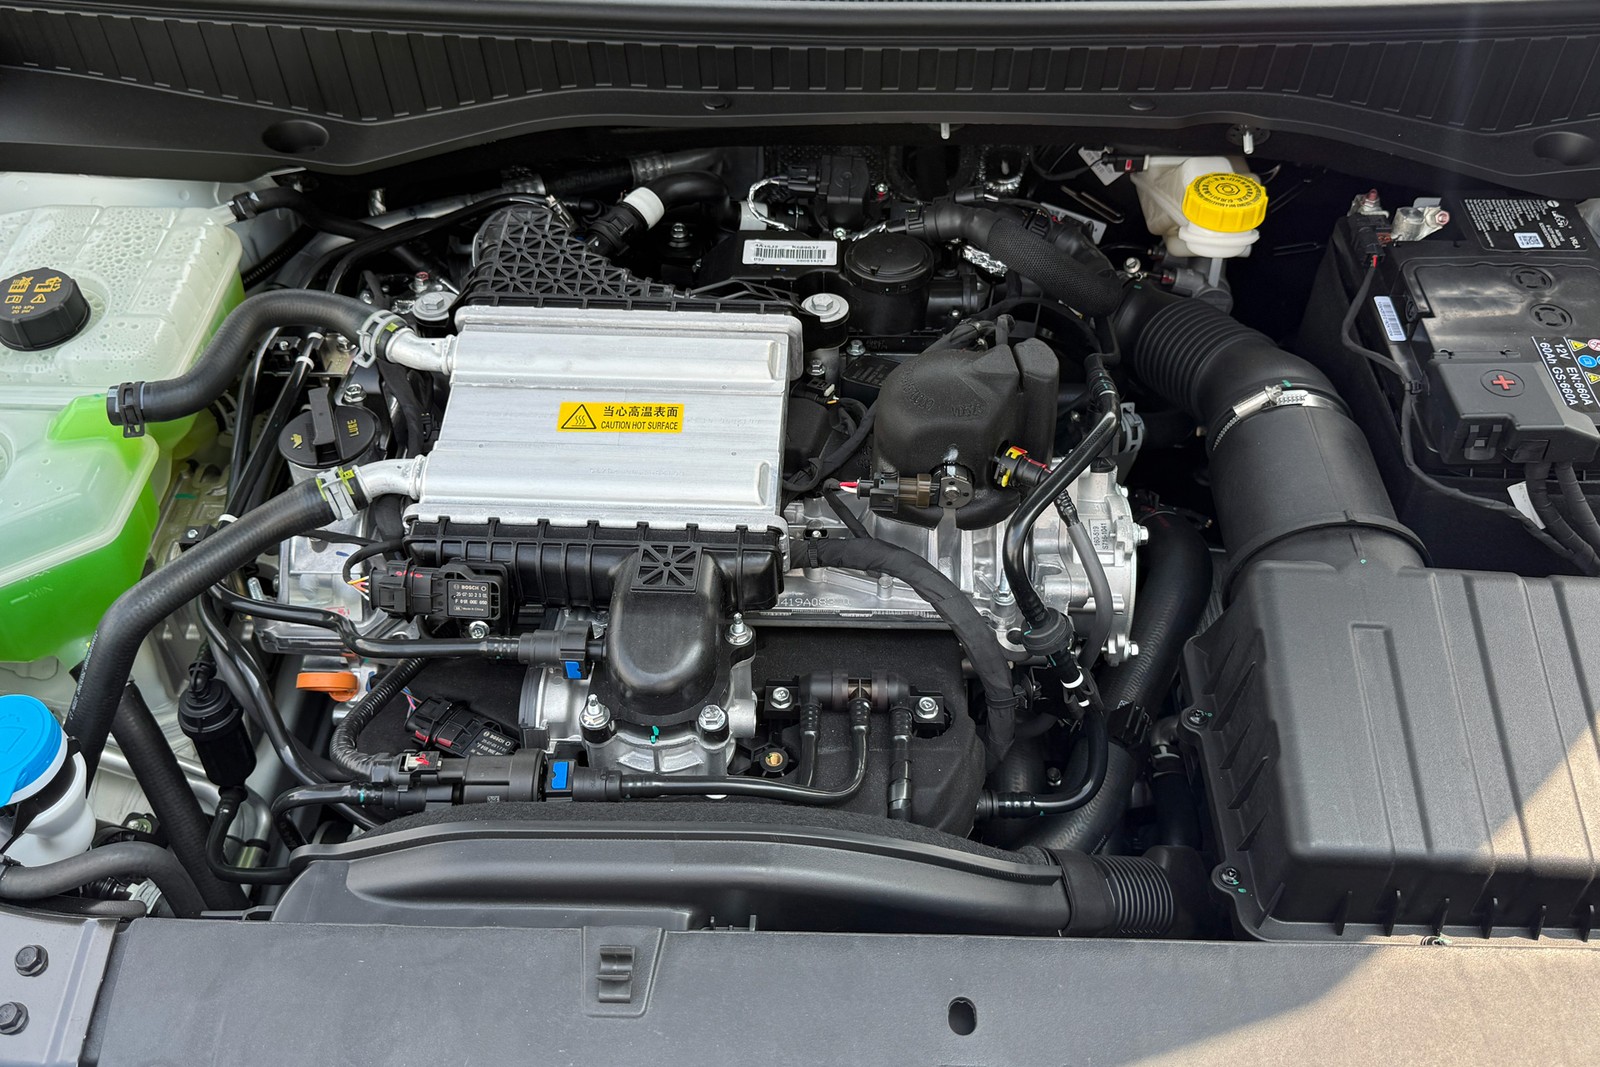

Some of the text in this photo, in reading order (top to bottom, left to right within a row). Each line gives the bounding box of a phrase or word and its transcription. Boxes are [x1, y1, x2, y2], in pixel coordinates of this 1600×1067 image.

[1539, 342, 1579, 406] 60Ah GS:660A
[1554, 343, 1594, 406] 12V EN:660A
[603, 405, 679, 418] 当心高温表面
[346, 418, 360, 437] LUBE
[600, 420, 632, 430] CAUTION
[632, 421, 646, 430] HOT
[647, 421, 679, 431] SURFACE
[489, 734, 506, 744] BOSCH
